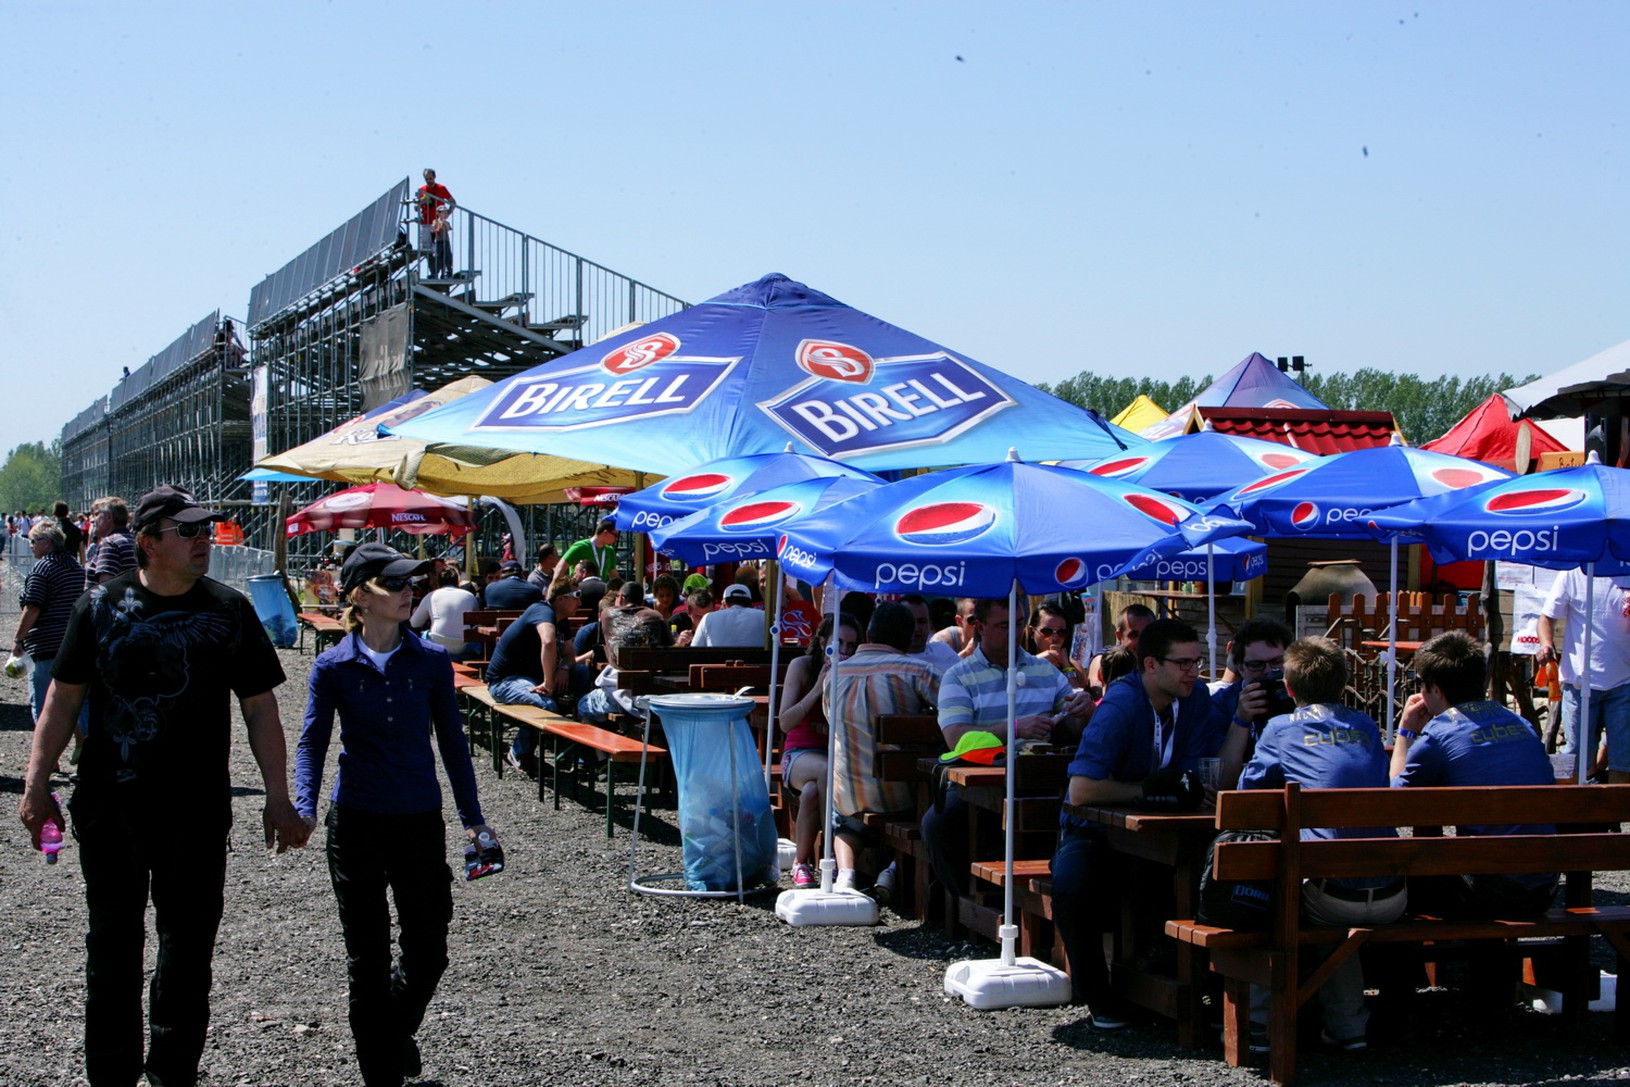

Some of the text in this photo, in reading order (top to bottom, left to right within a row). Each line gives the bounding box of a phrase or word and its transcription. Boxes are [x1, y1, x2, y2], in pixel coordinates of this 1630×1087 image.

[499, 374, 690, 420] BIRELL
[790, 372, 987, 443] BIRELL
[702, 538, 770, 561] pepsi
[783, 543, 818, 569] pepsi
[1467, 525, 1559, 558] pepsi
[874, 560, 966, 591] pepsi
[1156, 560, 1207, 580] peps
